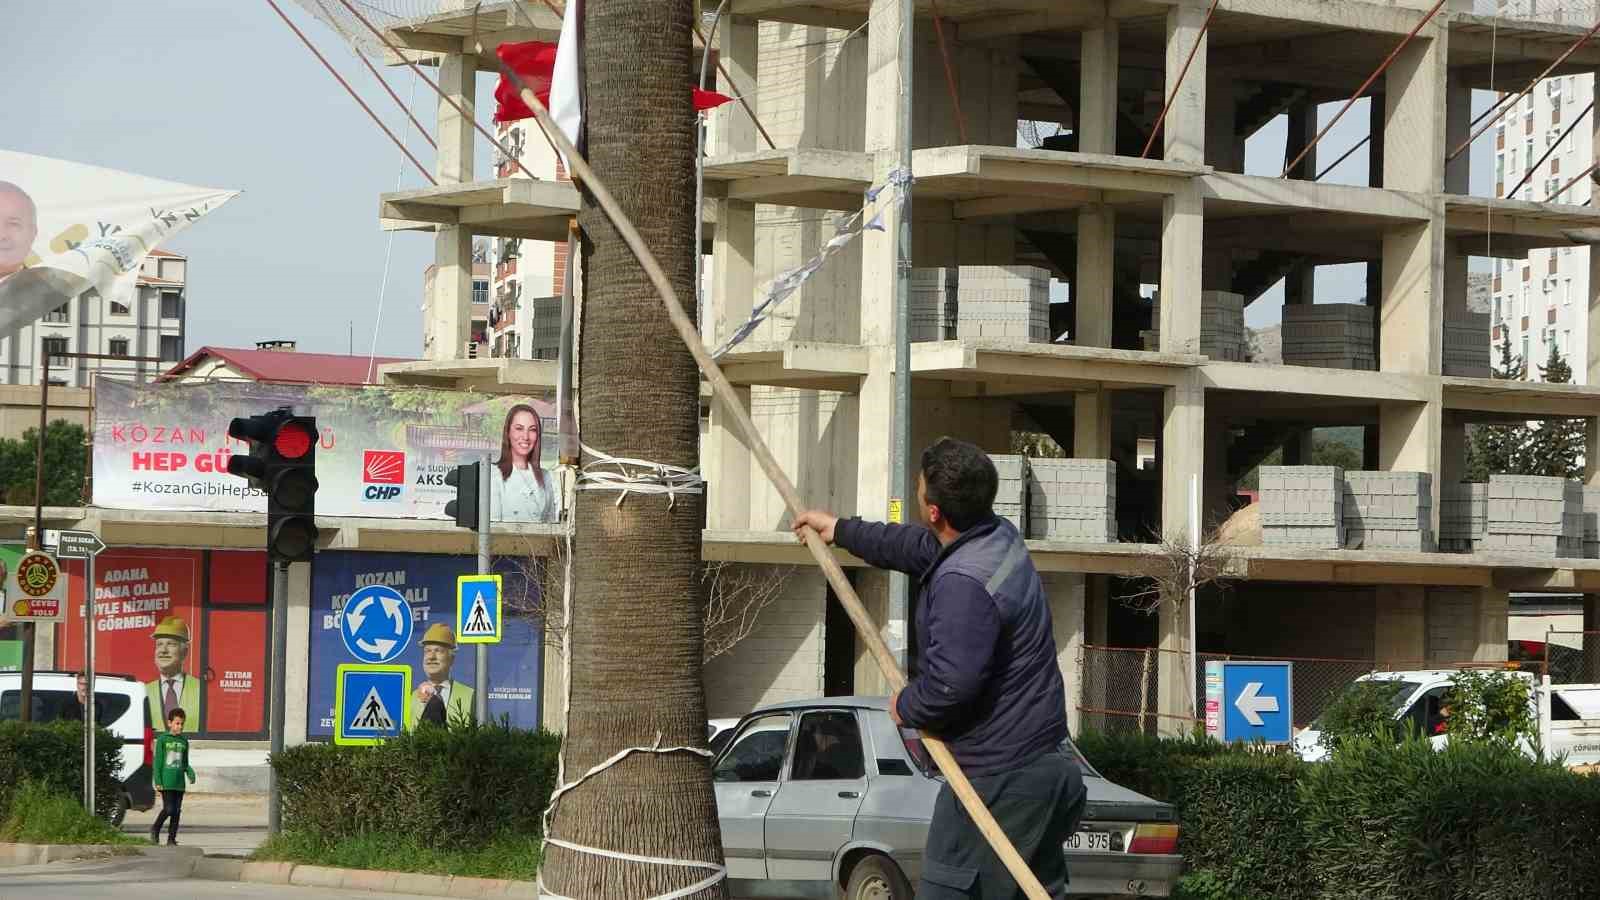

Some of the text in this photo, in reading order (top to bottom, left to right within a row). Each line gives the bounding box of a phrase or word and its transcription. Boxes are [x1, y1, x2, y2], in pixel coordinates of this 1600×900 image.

[111, 424, 207, 444] KOZAN
[131, 452, 191, 472] HEP
[416, 474, 443, 486] AKS
[132, 481, 269, 499] #KozanGibiHepSa
[364, 485, 401, 500] CHP
[104, 567, 149, 583] ADANA
[354, 570, 406, 587] KOZAN
[95, 581, 169, 600] DANA OLALI
[405, 587, 428, 603] ALI
[122, 596, 170, 613] HİZMET
[97, 611, 157, 631] GÖRMEDİ
[1088, 833, 1108, 849] 975
